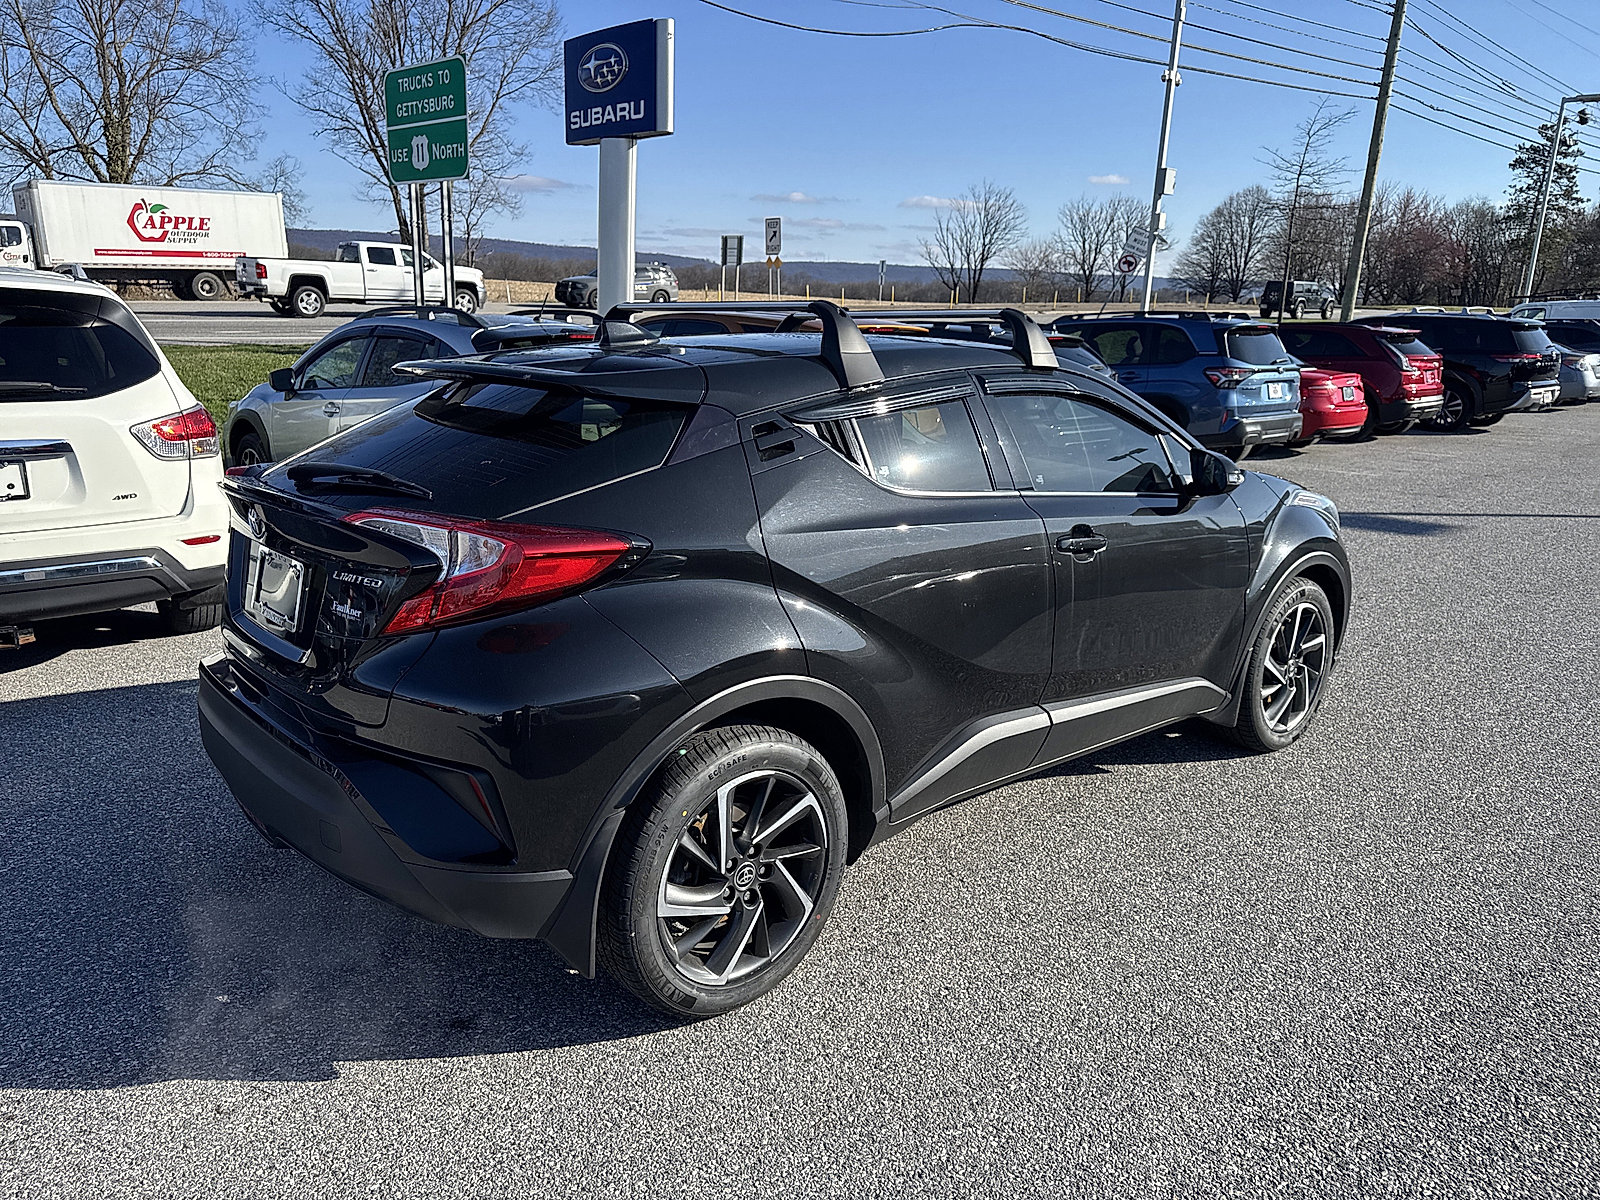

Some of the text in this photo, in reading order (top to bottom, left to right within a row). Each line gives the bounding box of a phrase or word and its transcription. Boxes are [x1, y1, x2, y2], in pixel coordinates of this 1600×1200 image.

[397, 69, 450, 93] TRUCKS TO
[396, 94, 455, 118] GETTYSBURG
[570, 99, 645, 130] SUBARU
[391, 142, 465, 163] USE 11 NORTH
[142, 214, 211, 231] APPLE
[111, 492, 138, 501] 4WD
[332, 570, 383, 588] LIMITED
[332, 600, 362, 617] Faulkner
